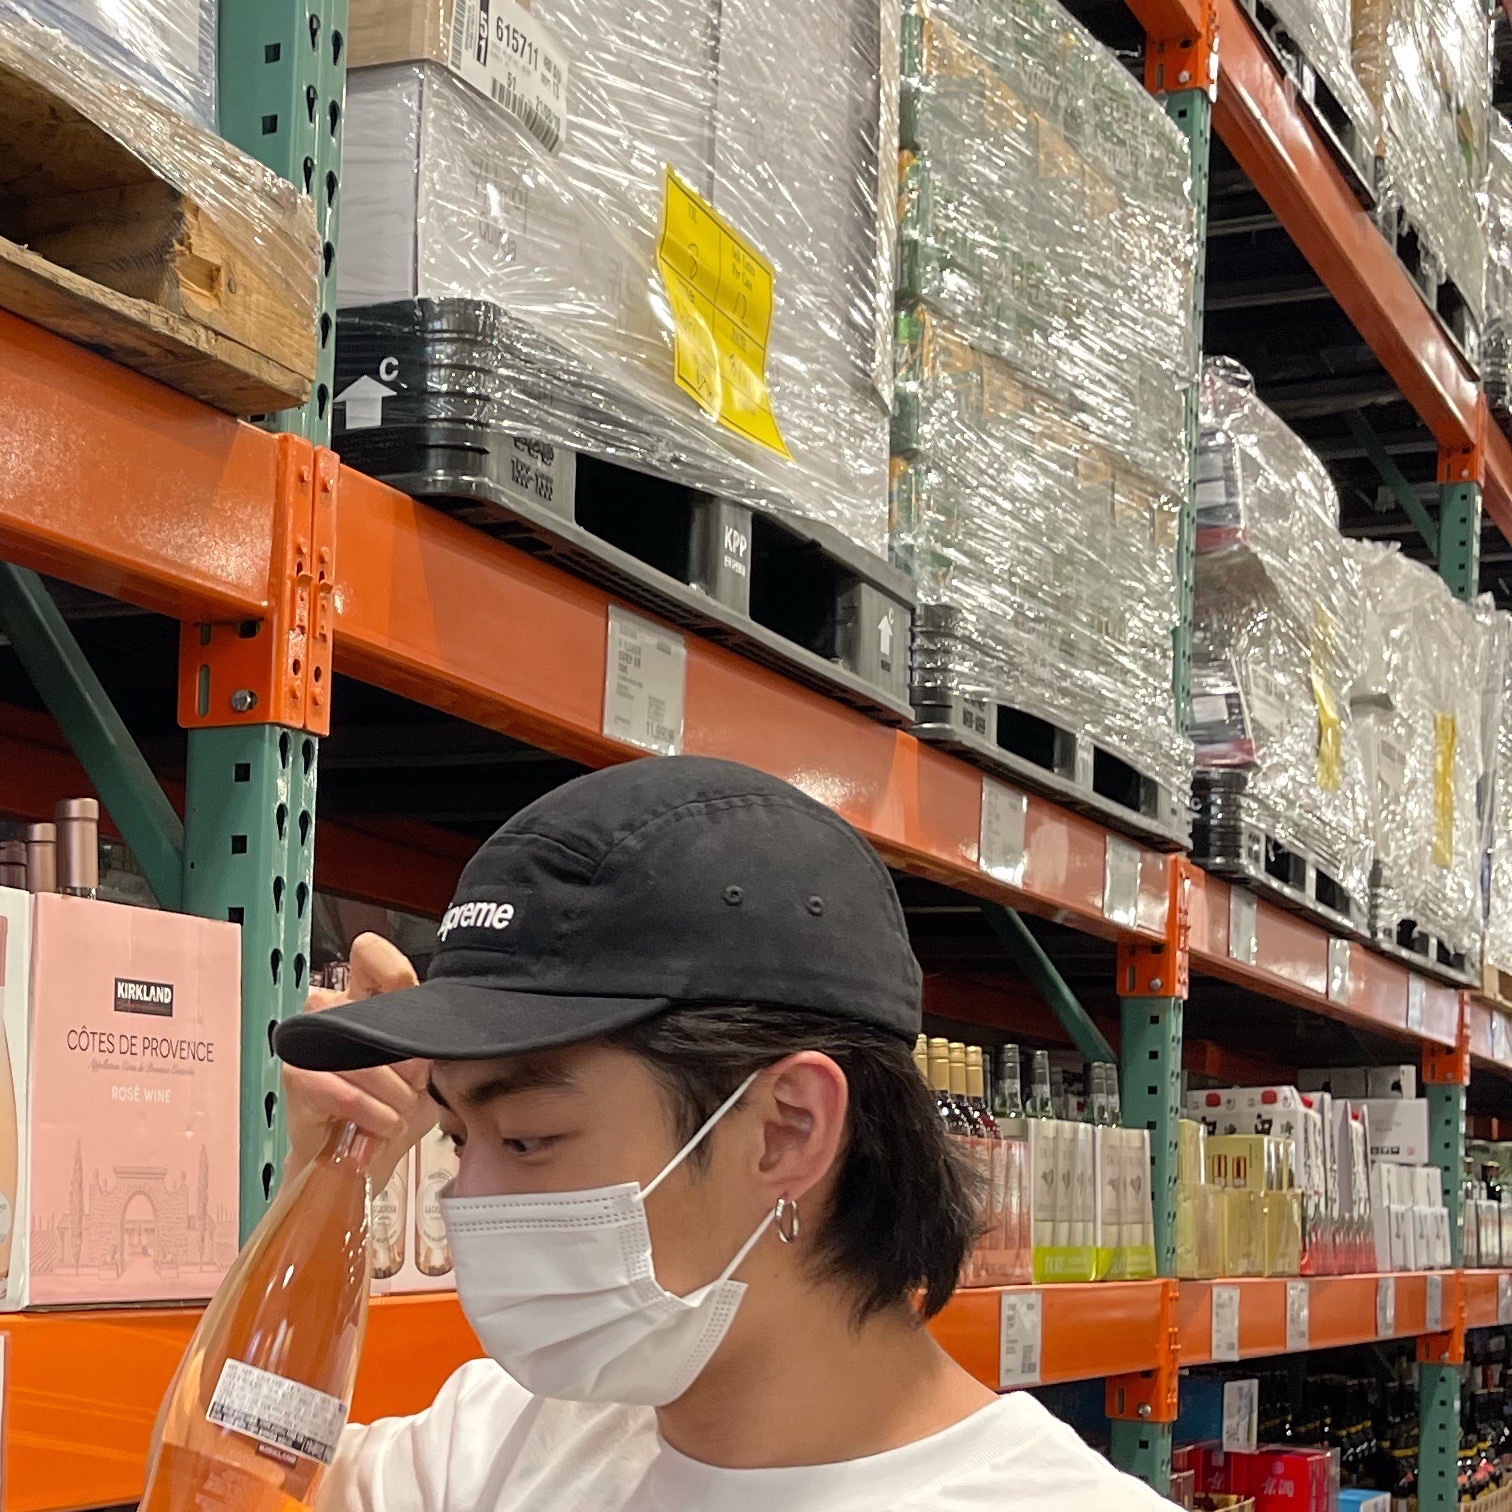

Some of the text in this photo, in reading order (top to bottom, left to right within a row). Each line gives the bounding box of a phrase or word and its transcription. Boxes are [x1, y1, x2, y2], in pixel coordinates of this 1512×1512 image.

[496, 16, 538, 71] 615711
[379, 357, 399, 382] C
[724, 525, 747, 557] KPP
[437, 901, 514, 942] preme
[117, 981, 172, 1004] KIRKLAND
[67, 1024, 214, 1062] CÔTES DE PROVENCE
[111, 1084, 172, 1104] ROSÉ WINE
